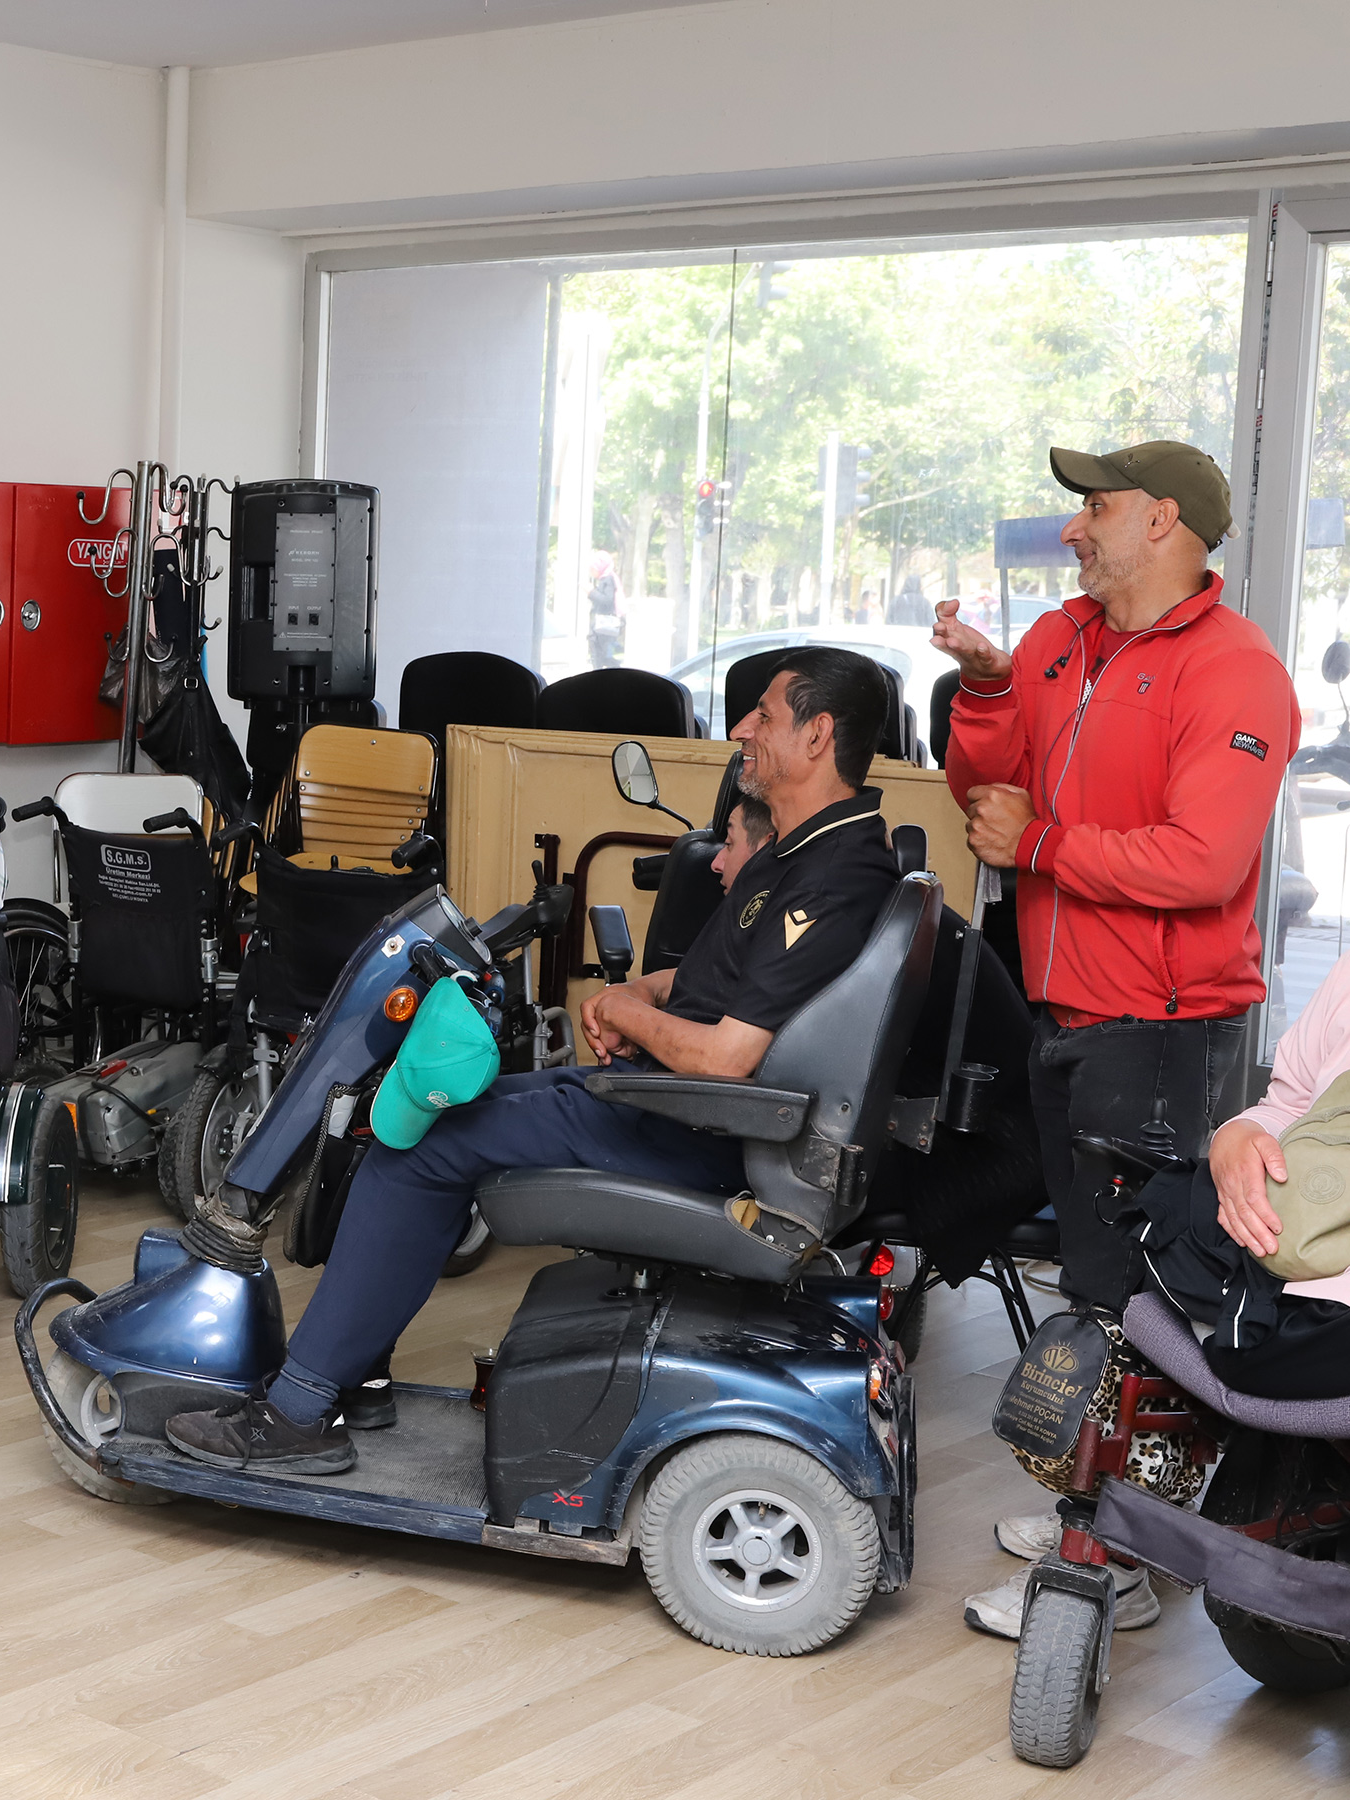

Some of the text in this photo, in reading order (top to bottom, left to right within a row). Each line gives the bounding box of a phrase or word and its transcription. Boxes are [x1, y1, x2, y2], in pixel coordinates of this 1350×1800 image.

[76, 542, 125, 560] YANGN
[1235, 733, 1257, 745] GANT
[1021, 1362, 1083, 1399] Birinciel
[1021, 1380, 1065, 1405] Kuyumculuk
[1034, 1405, 1063, 1425] POÇAN
